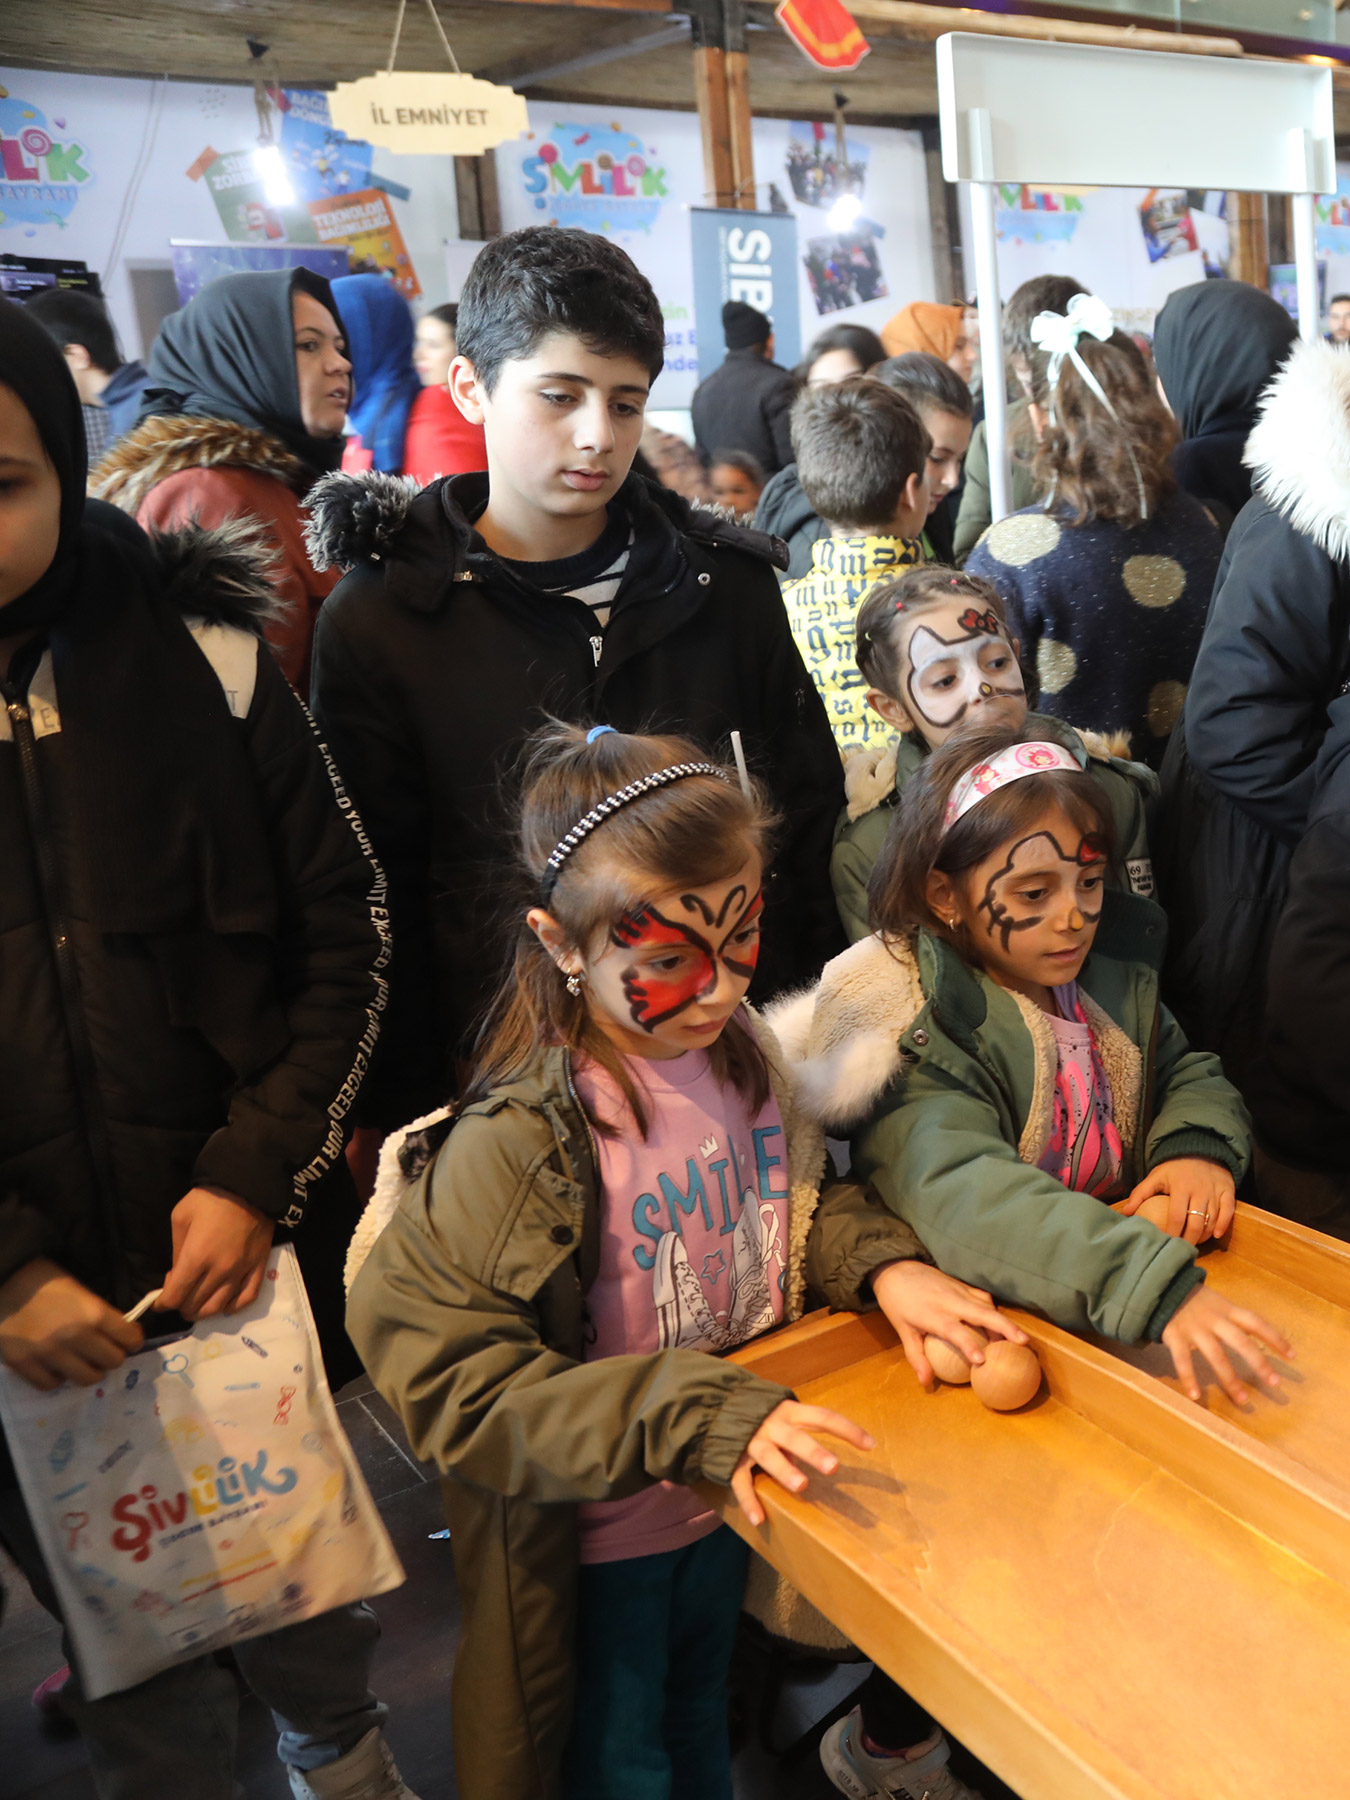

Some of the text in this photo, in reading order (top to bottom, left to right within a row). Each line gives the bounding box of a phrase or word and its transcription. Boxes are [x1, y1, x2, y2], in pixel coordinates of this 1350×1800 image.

[371, 103, 488, 126] İL EMNİYET
[344, 810, 374, 856] YOUR
[365, 858, 388, 904] LIMIT
[327, 1052, 368, 1121] EXCEED
[293, 1155, 330, 1202] LIMIT
[632, 1126, 789, 1270] SMILE
